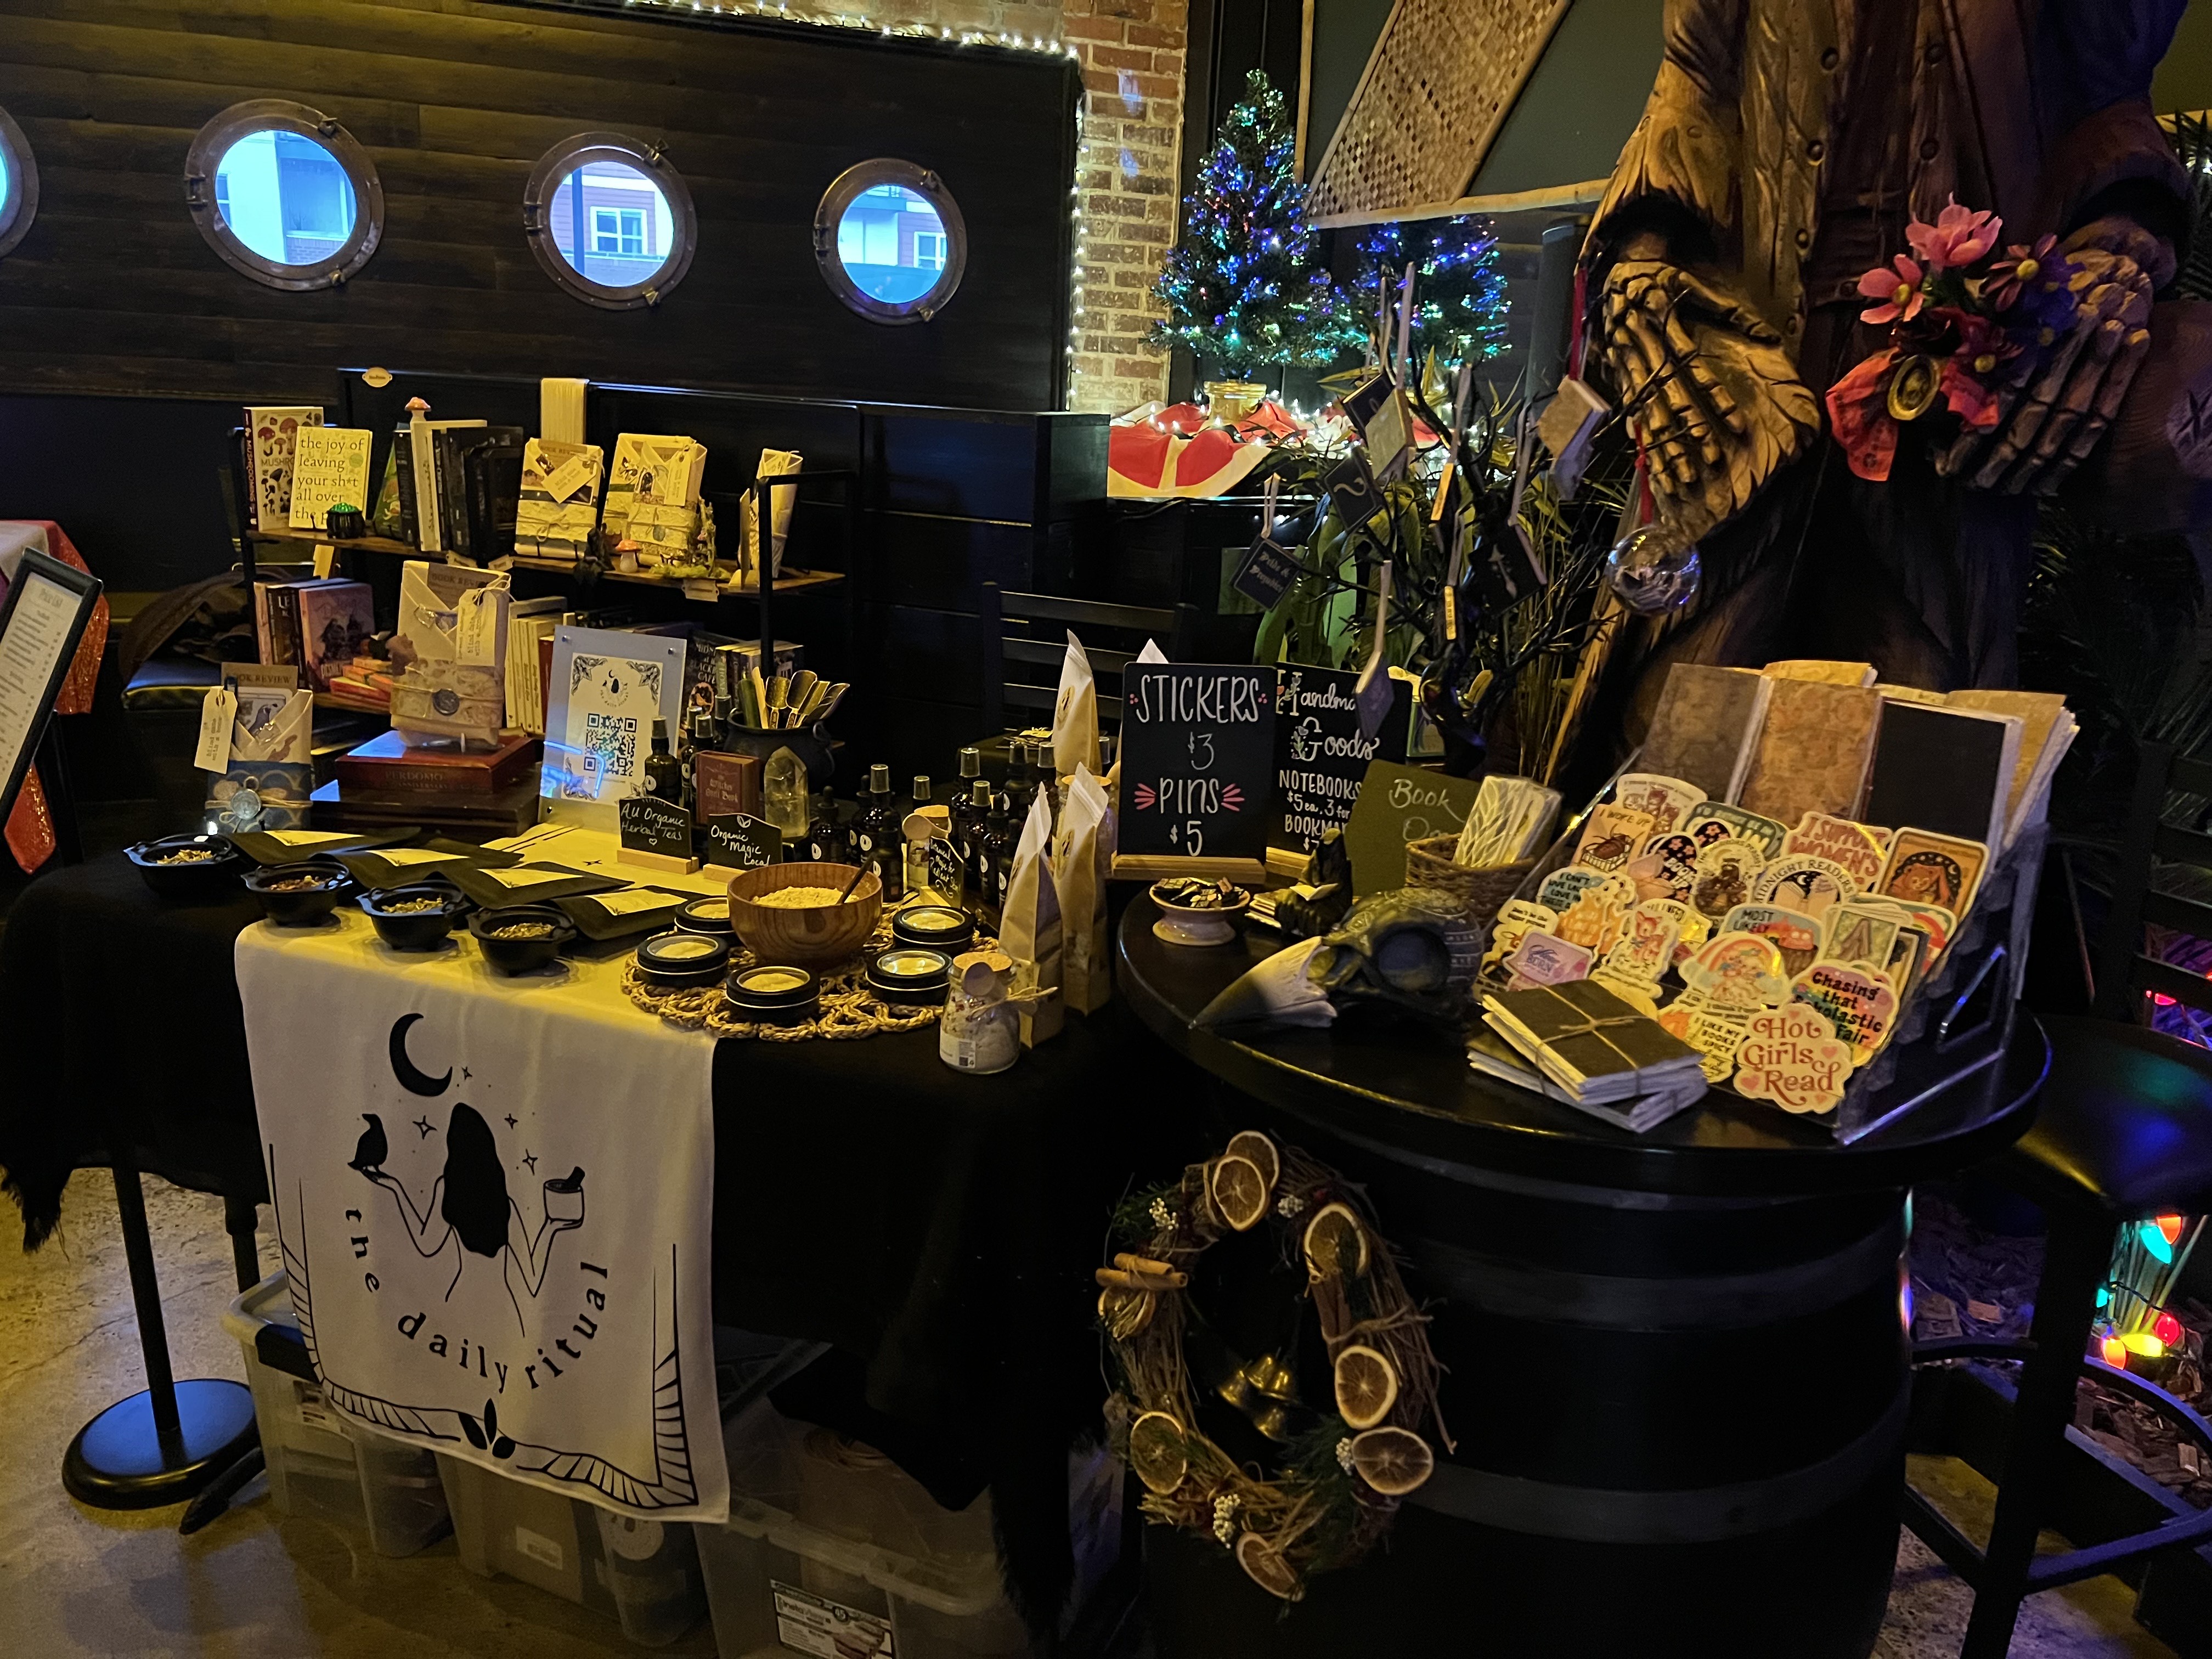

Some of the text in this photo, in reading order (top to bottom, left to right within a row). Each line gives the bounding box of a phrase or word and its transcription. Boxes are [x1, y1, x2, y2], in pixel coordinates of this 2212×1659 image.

[301, 436, 365, 455] the joy of
[261, 458, 295, 467] MUSHRO
[299, 454, 345, 472] leaving
[298, 477, 328, 489] your
[296, 489, 344, 502] all over
[296, 507, 315, 519] the
[256, 675, 292, 684] REVIEW
[1136, 674, 1259, 723] STICKERS
[1276, 669, 1356, 716] Handma
[1188, 731, 1215, 771] $3
[1279, 769, 1362, 800] NOTEBOOKS
[645, 808, 686, 828] Organic
[1285, 814, 1347, 837] BOOKM
[661, 827, 682, 840] Teas
[711, 825, 748, 846] Organic
[1755, 859, 1854, 903] MIDNIGHT READERS
[1741, 910, 1774, 922] MOST
[1812, 971, 1880, 1001] Chasing
[1822, 990, 1858, 1010] that
[1753, 1017, 1822, 1039] Hot
[1836, 1024, 1870, 1043] Fair
[1743, 1042, 1814, 1072] Girls
[1764, 1060, 1841, 1106] Read
[345, 1207, 609, 1394] the daily ritual
